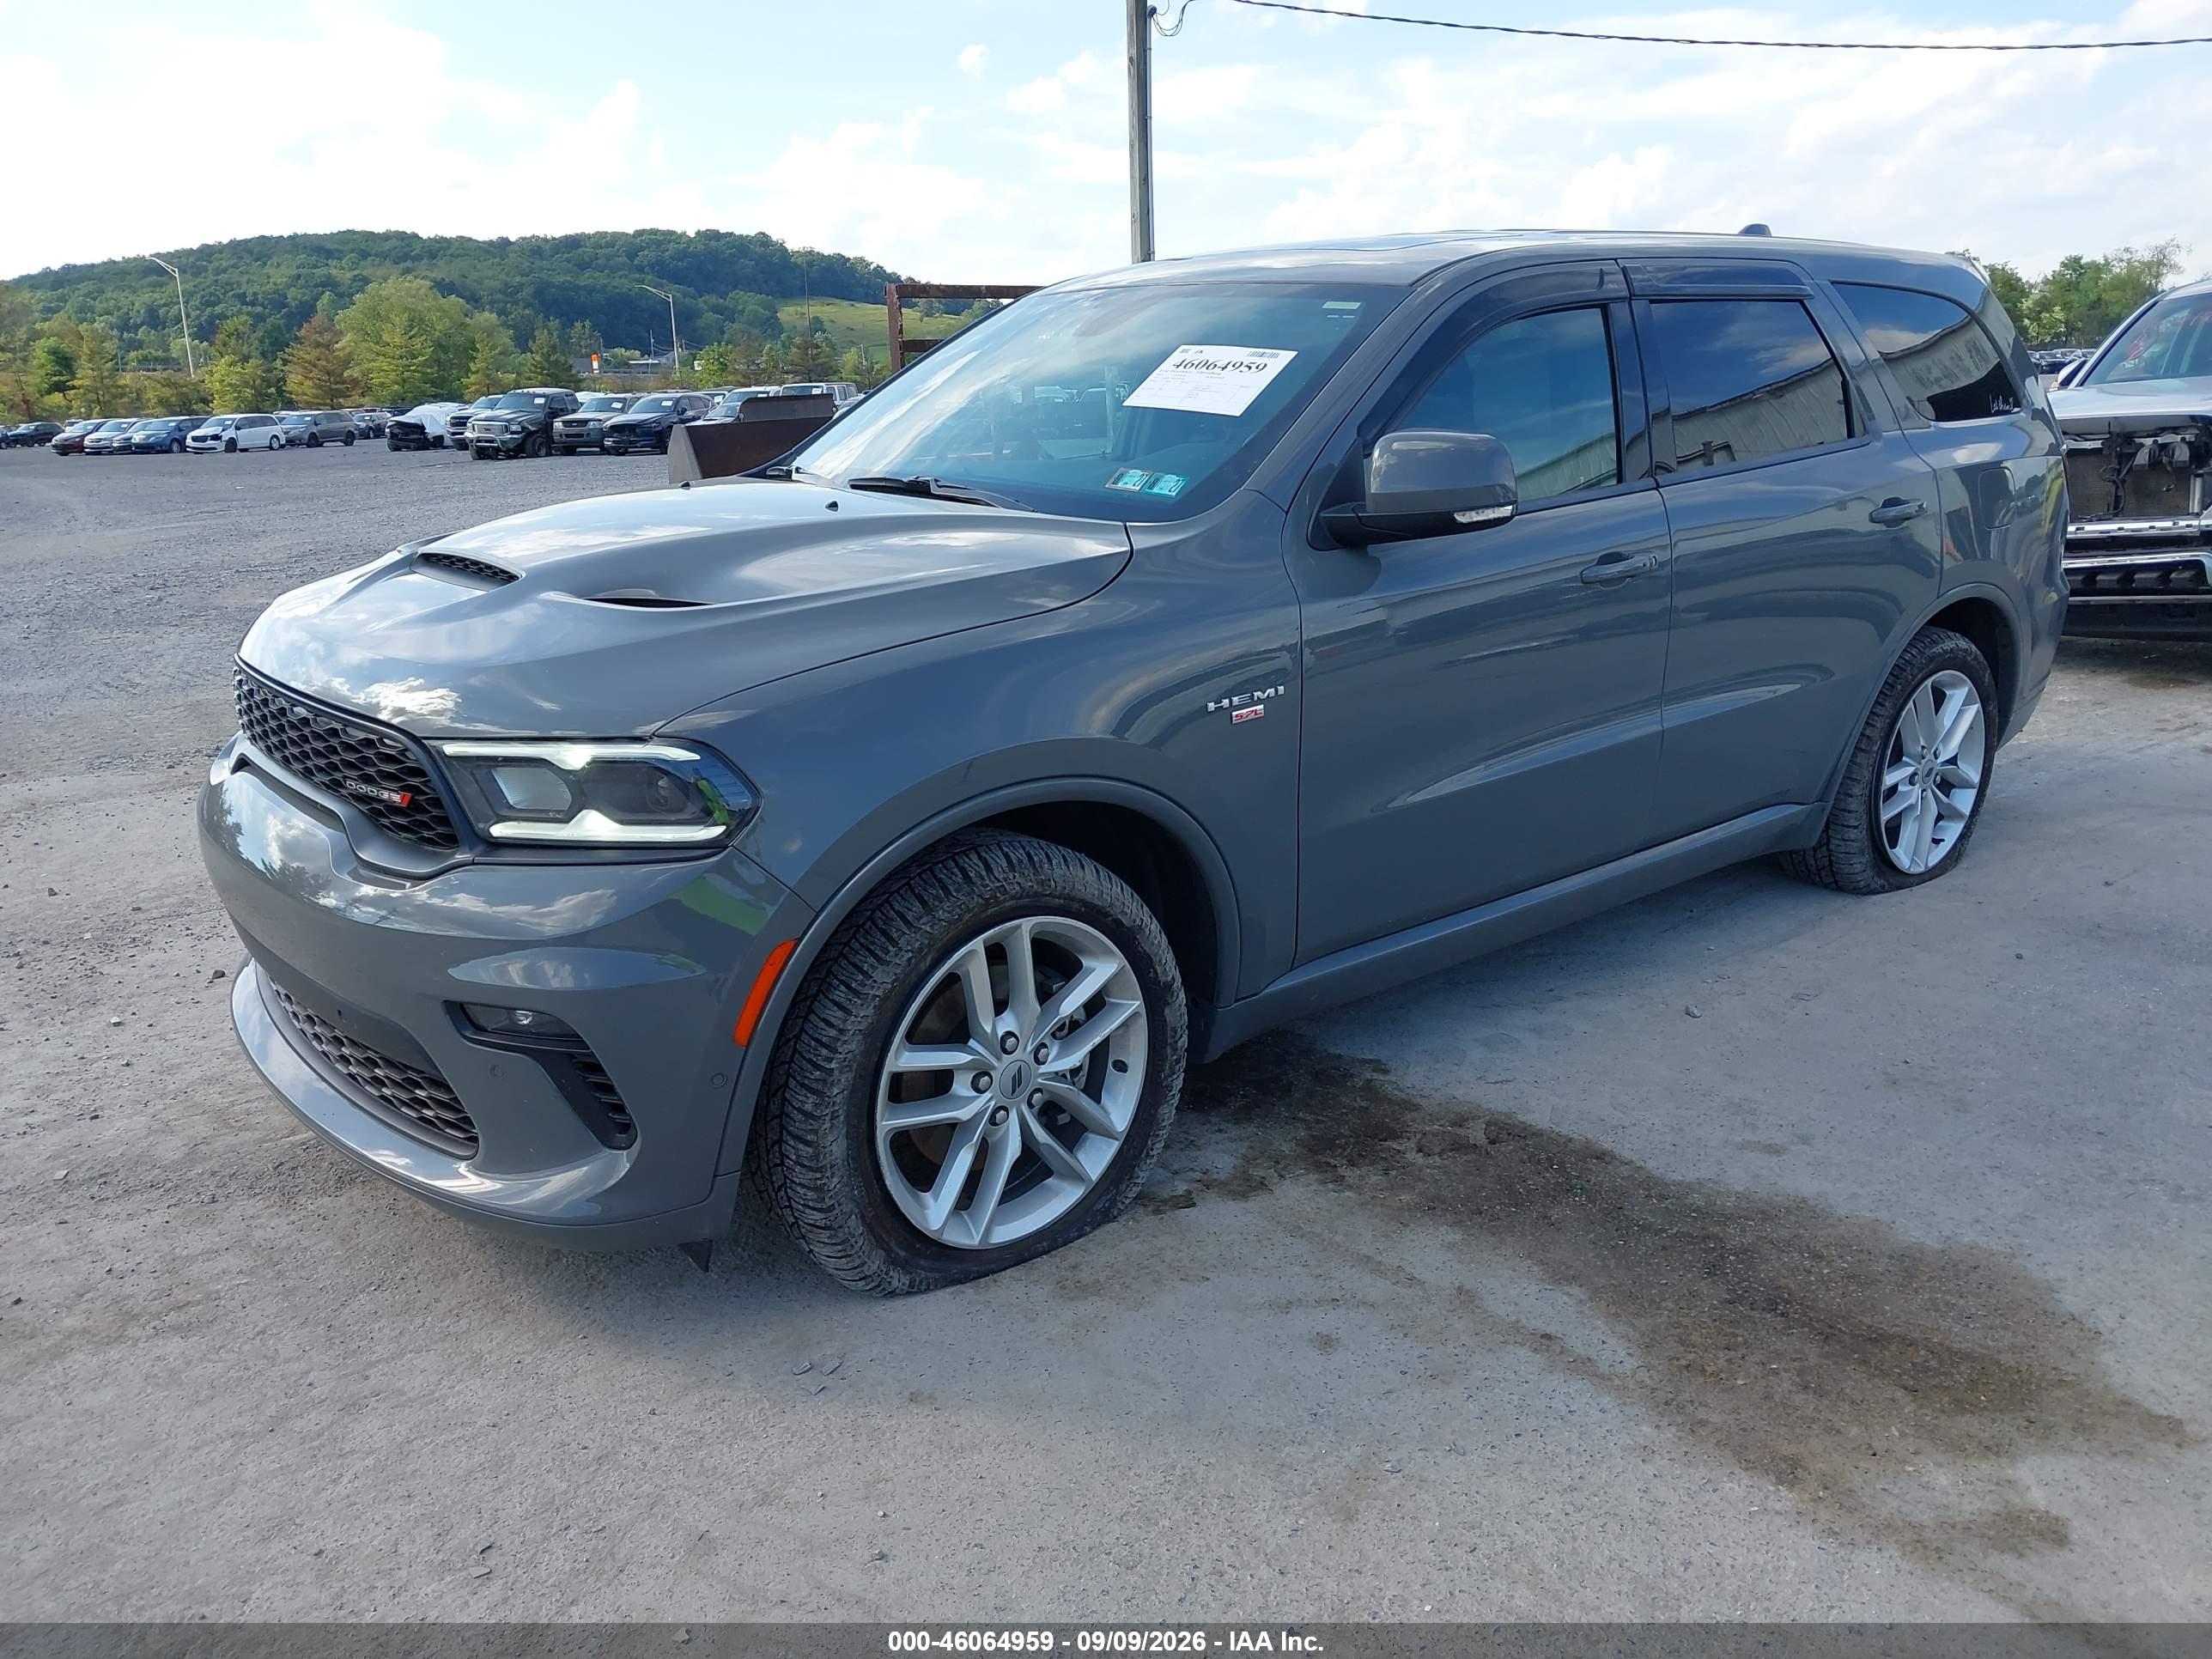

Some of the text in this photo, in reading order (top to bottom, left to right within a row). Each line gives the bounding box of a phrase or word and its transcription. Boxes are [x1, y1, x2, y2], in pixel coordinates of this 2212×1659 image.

[1173, 358, 1267, 374] 46064959
[1206, 685, 1285, 712] HEMI
[345, 781, 402, 803] DODGE
